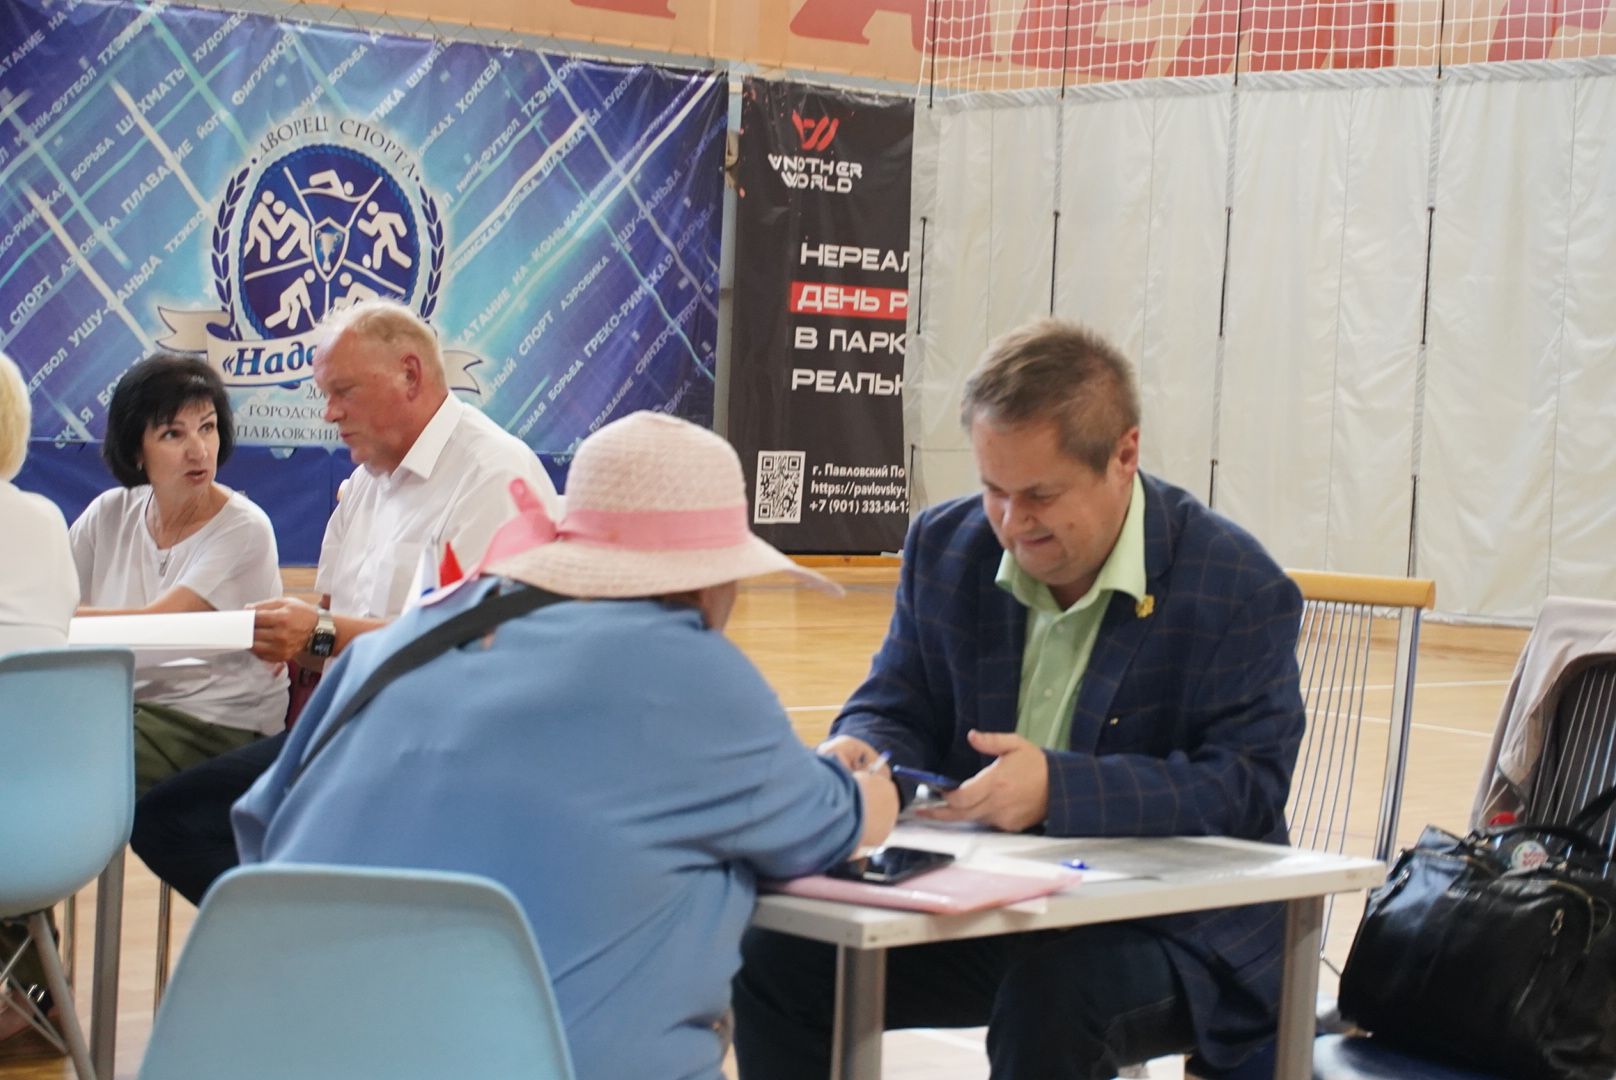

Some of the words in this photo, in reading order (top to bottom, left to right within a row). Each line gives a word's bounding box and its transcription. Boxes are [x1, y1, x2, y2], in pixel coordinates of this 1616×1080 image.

[14, 66, 97, 147] МНИ-ФУТБОЛ
[455, 57, 501, 114] ХОККЕЙ
[71, 137, 115, 182] БОРЬБА
[115, 62, 188, 136] ШХМАТЫ
[259, 116, 328, 160] ДВОРЕЦ
[340, 119, 415, 178] СПОРТА
[541, 108, 602, 178] ШАХМАЫ
[781, 171, 853, 194] WORLD
[10, 274, 53, 325] СПОРТ
[61, 216, 120, 276] АЭОБКА
[121, 138, 193, 214] ПЛАВАИЕ
[518, 310, 554, 356] СПОРТ
[560, 255, 610, 311] АЭРОБИКА
[797, 284, 880, 312] ДЕНЬ
[794, 326, 818, 350] В
[829, 329, 906, 355] ПАРК
[548, 359, 585, 401] БОРЬБА
[812, 465, 822, 476] г.
[824, 463, 888, 478] Павловский
[809, 499, 826, 512] +7
[828, 499, 860, 515] (901)
